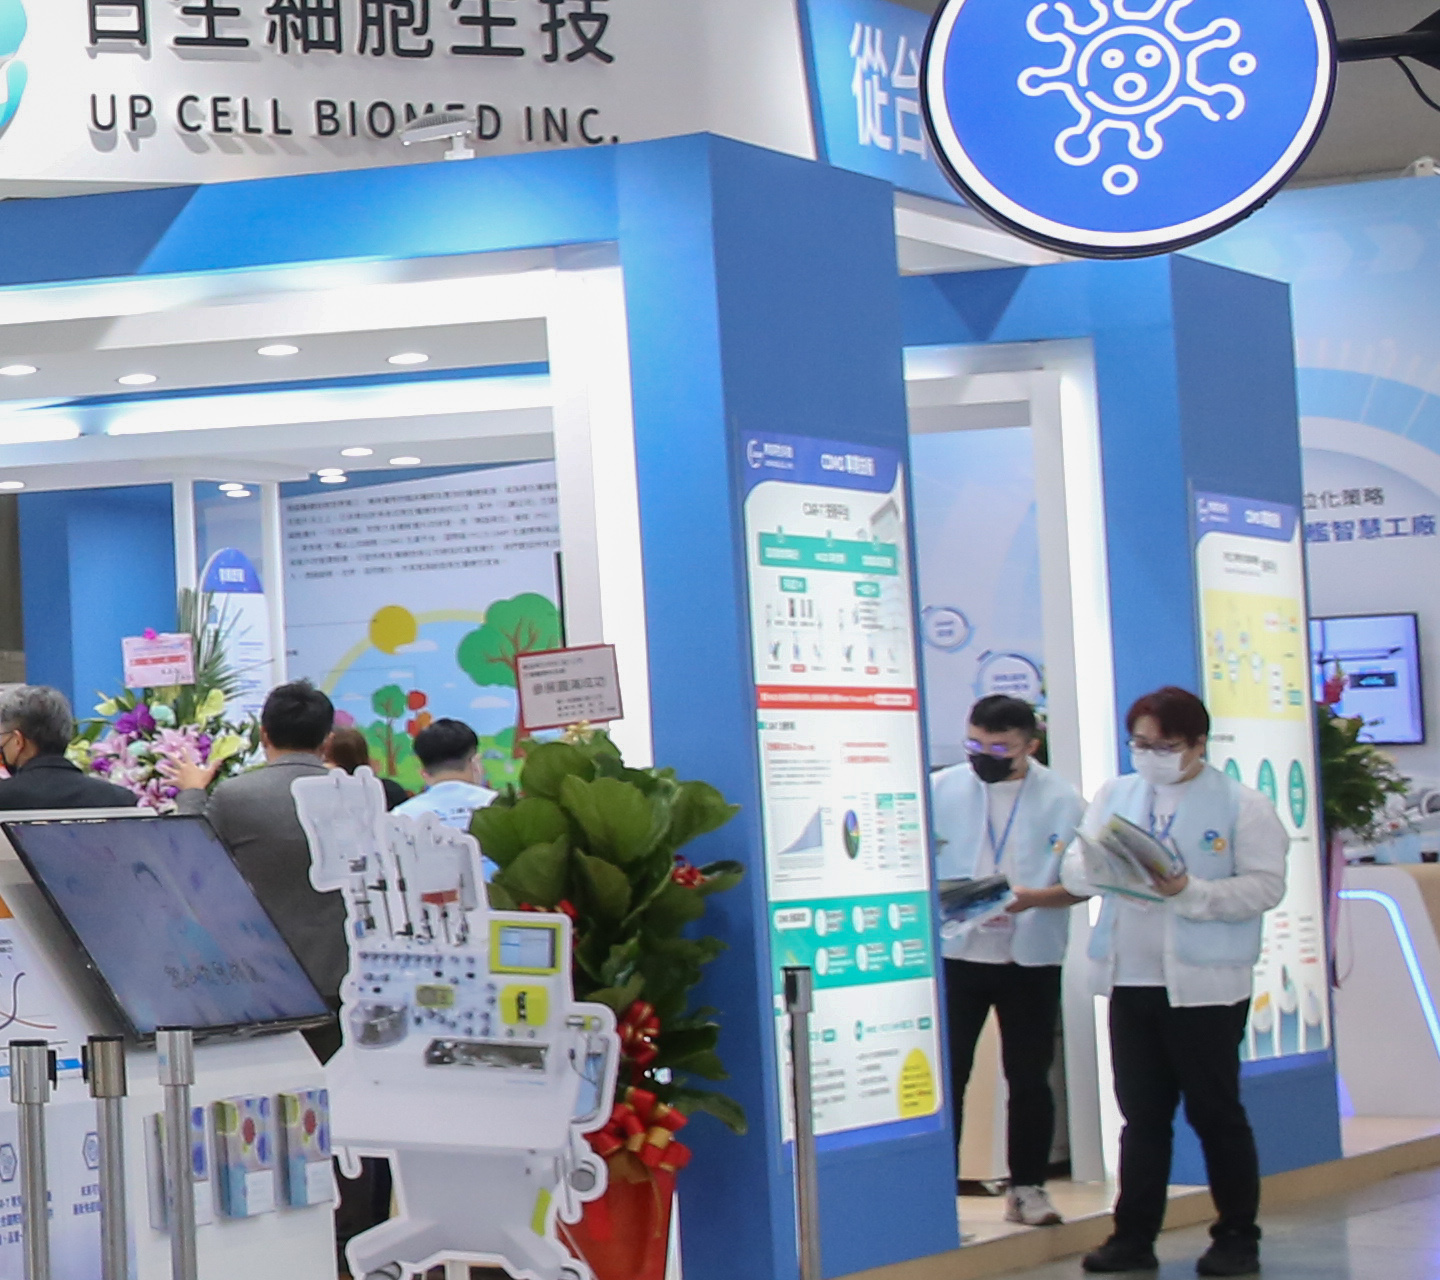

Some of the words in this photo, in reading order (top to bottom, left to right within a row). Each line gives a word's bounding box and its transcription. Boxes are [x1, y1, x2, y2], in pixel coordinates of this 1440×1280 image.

[90, 93, 154, 132] UP
[175, 95, 294, 136] CELL
[314, 98, 502, 141] BIOD
[524, 106, 620, 145] INC.
